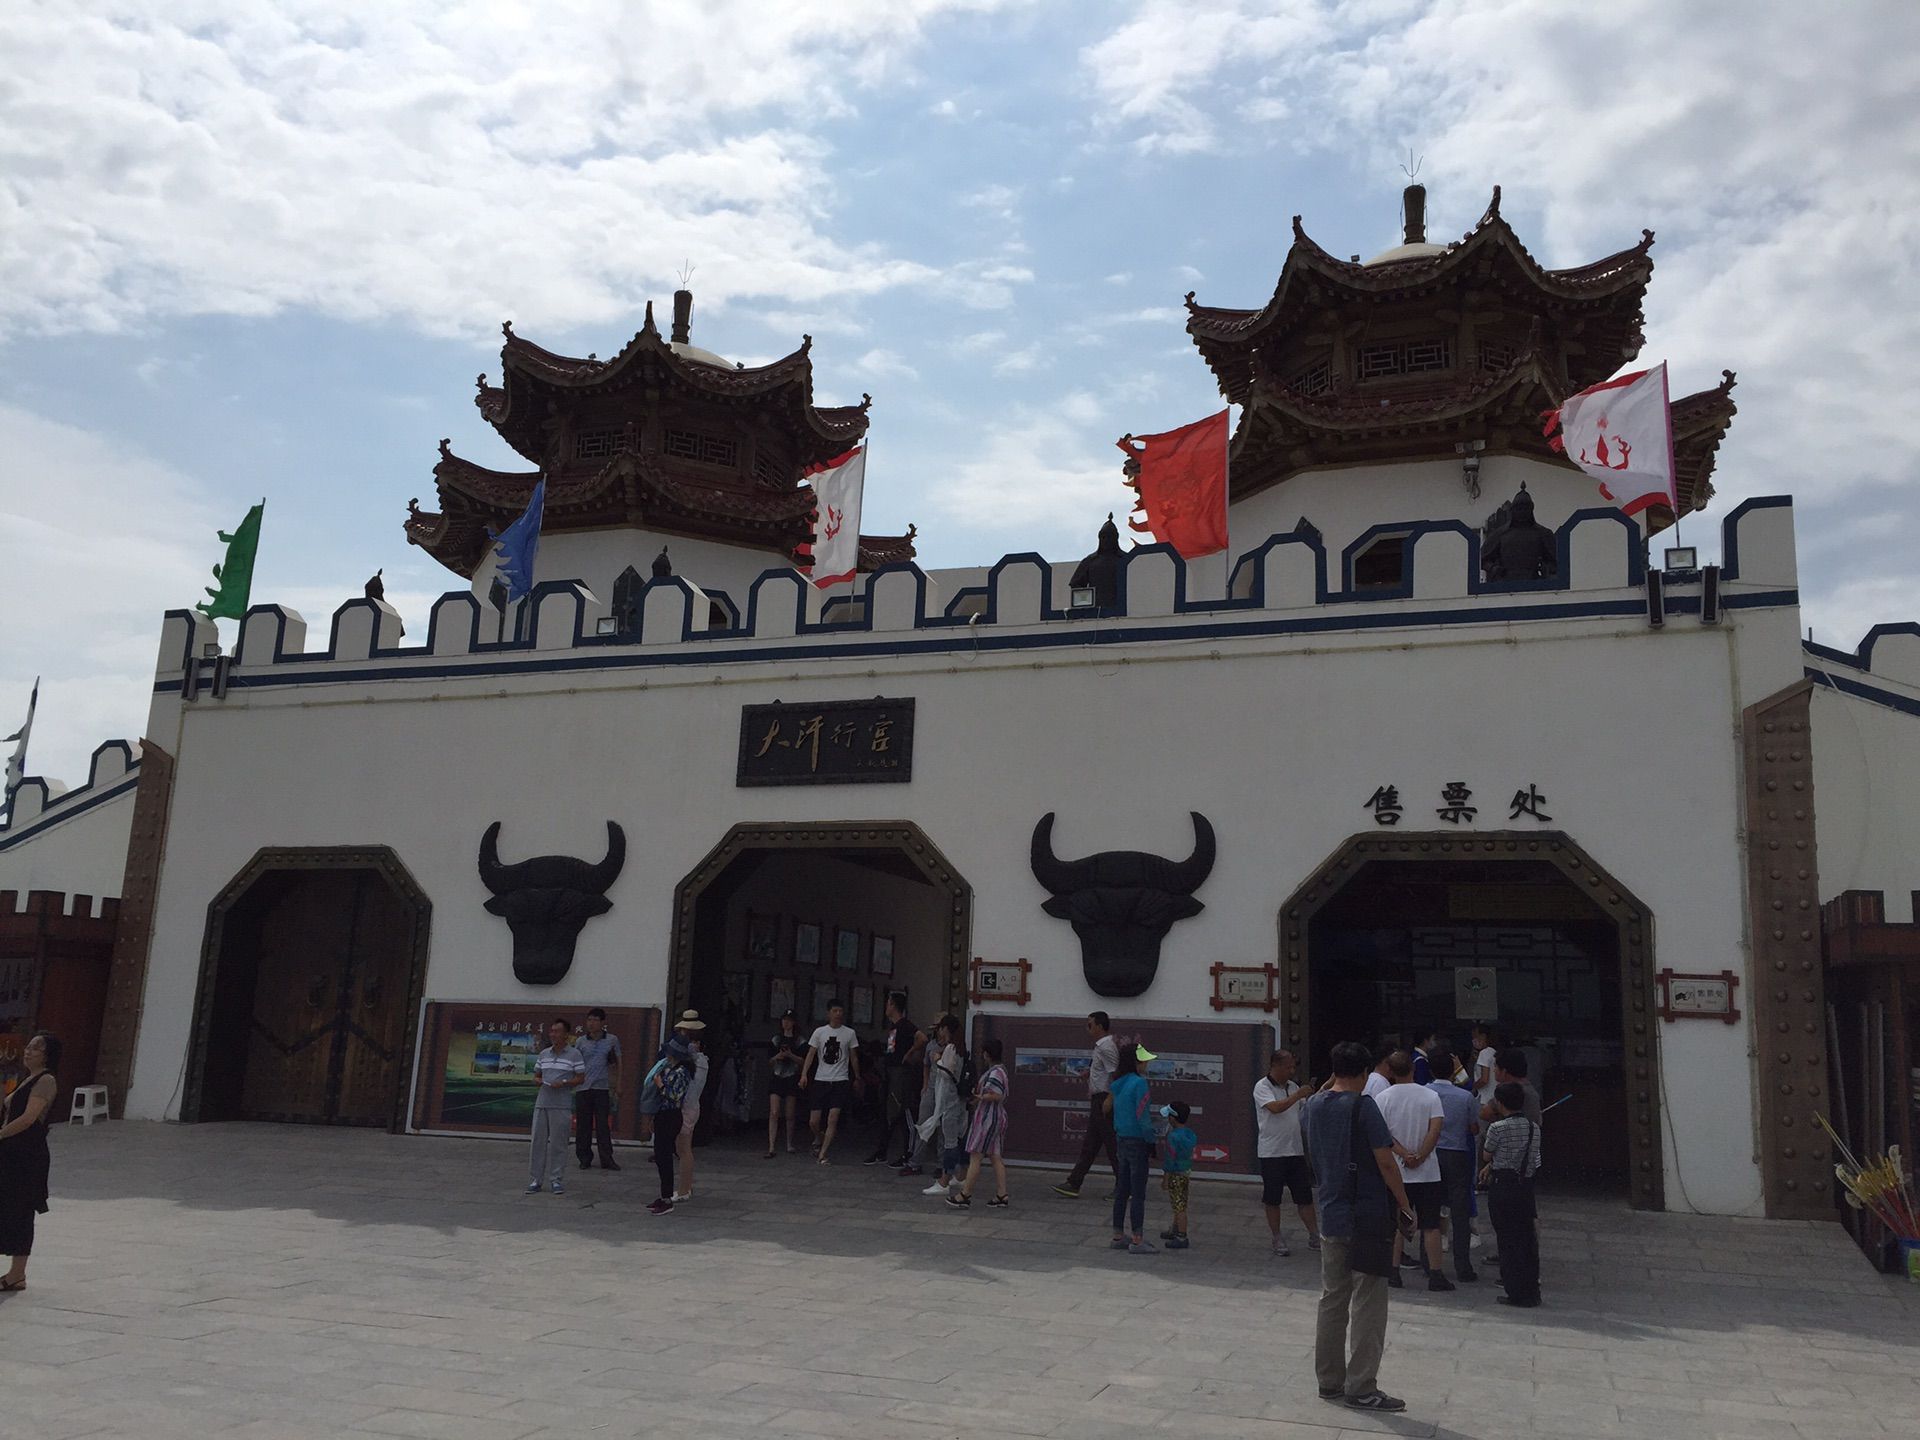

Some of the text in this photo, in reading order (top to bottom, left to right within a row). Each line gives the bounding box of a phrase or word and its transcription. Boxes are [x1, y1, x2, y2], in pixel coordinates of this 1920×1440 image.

[755, 714, 894, 773] 大汗行宫
[1363, 781, 1552, 825] 售票处
